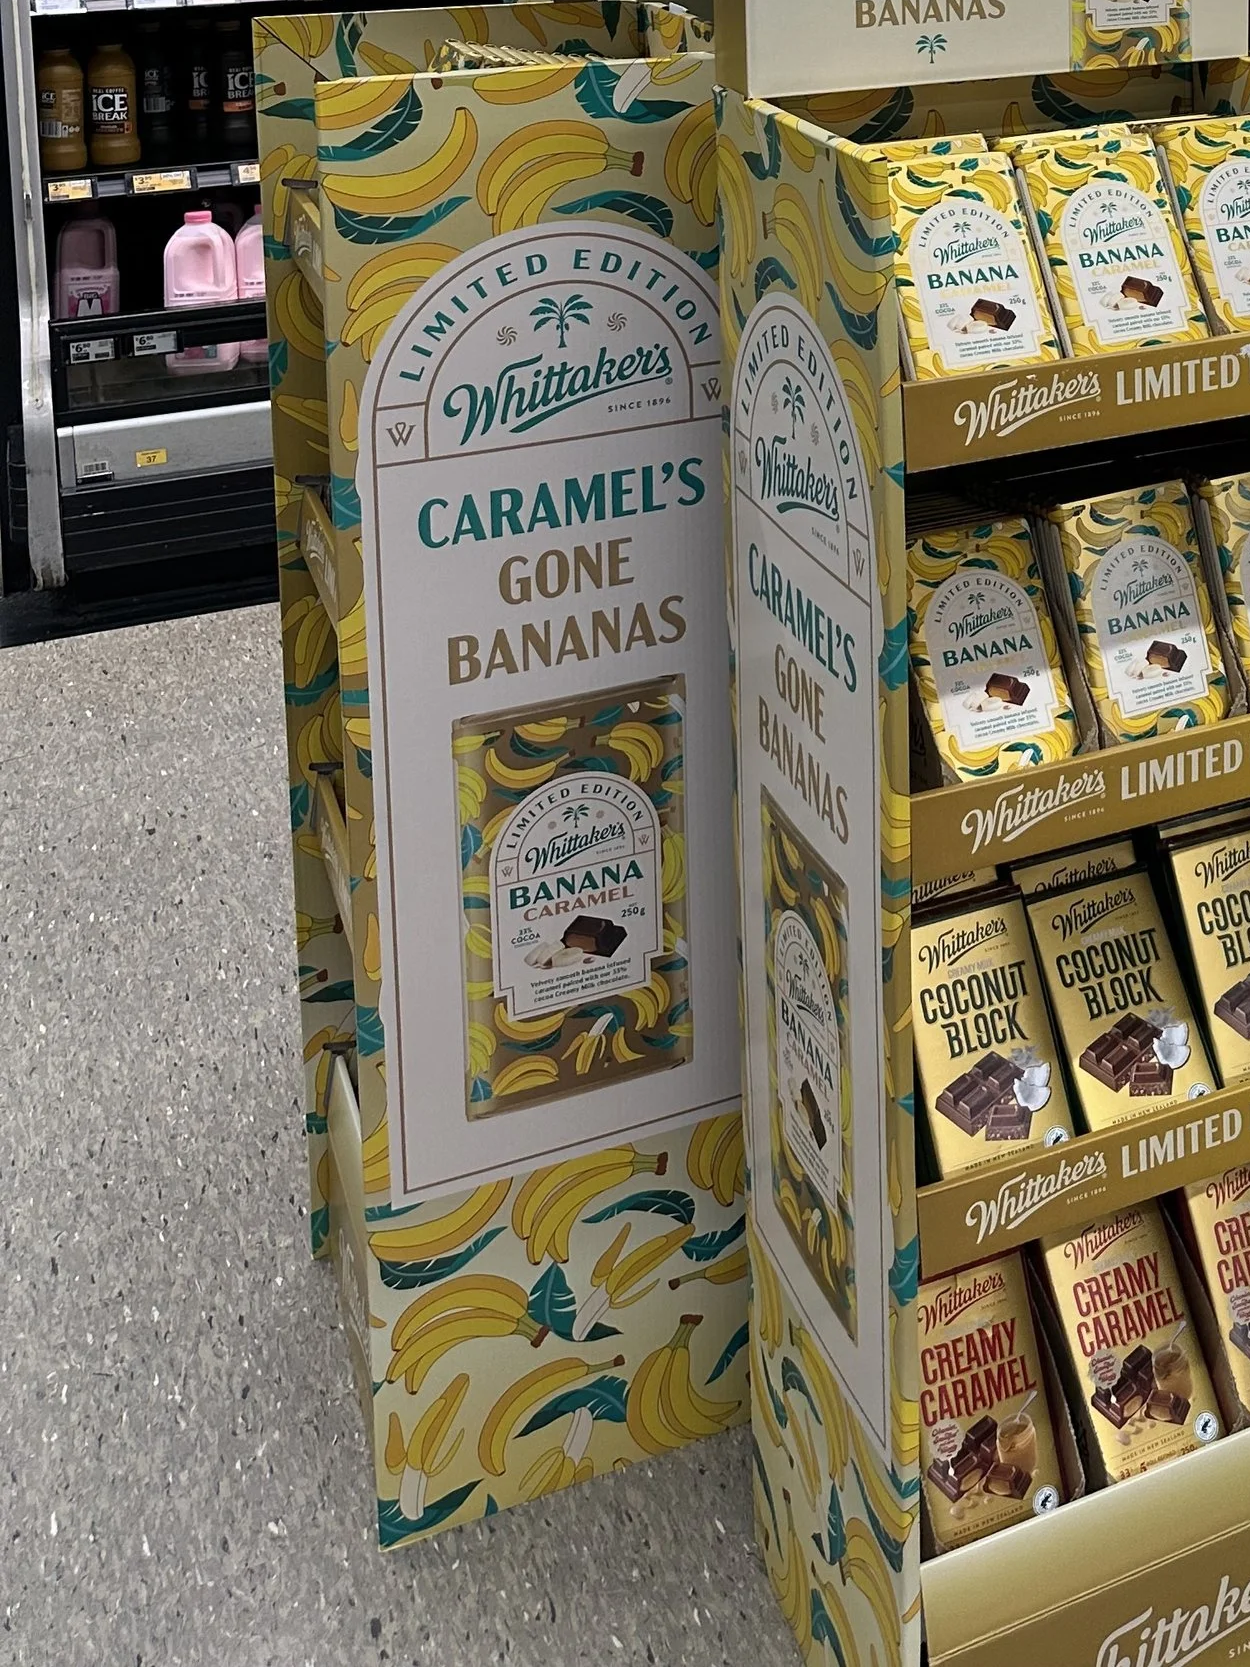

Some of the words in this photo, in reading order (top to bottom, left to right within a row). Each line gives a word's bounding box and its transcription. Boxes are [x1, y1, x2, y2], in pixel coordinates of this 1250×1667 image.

[92, 94, 128, 111] ICE
[92, 111, 128, 121] BREAK
[918, 208, 956, 248] LIMITED
[962, 207, 1010, 240] EDITION
[1079, 243, 1164, 269] BANANA
[927, 265, 1019, 290] BANANA
[400, 253, 548, 382] LIMITED
[573, 249, 712, 345] EDITION
[443, 343, 673, 445] Whittaker's
[608, 400, 643, 414] SINCE
[646, 397, 672, 408] 1896
[954, 372, 1102, 447] Whittaker's
[1116, 354, 1240, 406] LIMITED
[418, 457, 706, 549] CARAMEL'S
[755, 436, 840, 524] Whittaker's
[499, 537, 634, 606] GONE
[448, 595, 687, 686] BANANAS
[748, 543, 857, 693] CARAMEL'S
[1108, 603, 1191, 635] BANANA
[942, 634, 1033, 669] BANANA
[775, 643, 826, 744] GONE
[758, 694, 850, 845] BANANAS
[961, 768, 1107, 854] Whittaker's
[1120, 749, 1243, 801] LIMITED
[525, 821, 626, 875] Whittaker's
[509, 859, 644, 910] BANANA
[524, 888, 635, 922] CARAMEL
[1052, 888, 1137, 942] Whittaker's
[511, 933, 540, 944] COCOA
[919, 917, 1008, 975] Whittaker's
[1056, 927, 1162, 988] COCONUT
[919, 960, 1028, 1025] COCONUT
[1078, 966, 1164, 1021] BLOCK
[941, 1001, 1028, 1059] BLOCK
[965, 1151, 1108, 1244] Whittaker's
[1121, 1108, 1242, 1179] LIMITED
[1073, 1252, 1161, 1318] CREAMY
[921, 1318, 1016, 1386] CREAMY
[1076, 1286, 1186, 1358] CARAMEL
[919, 1355, 1037, 1429] CARAMEL
